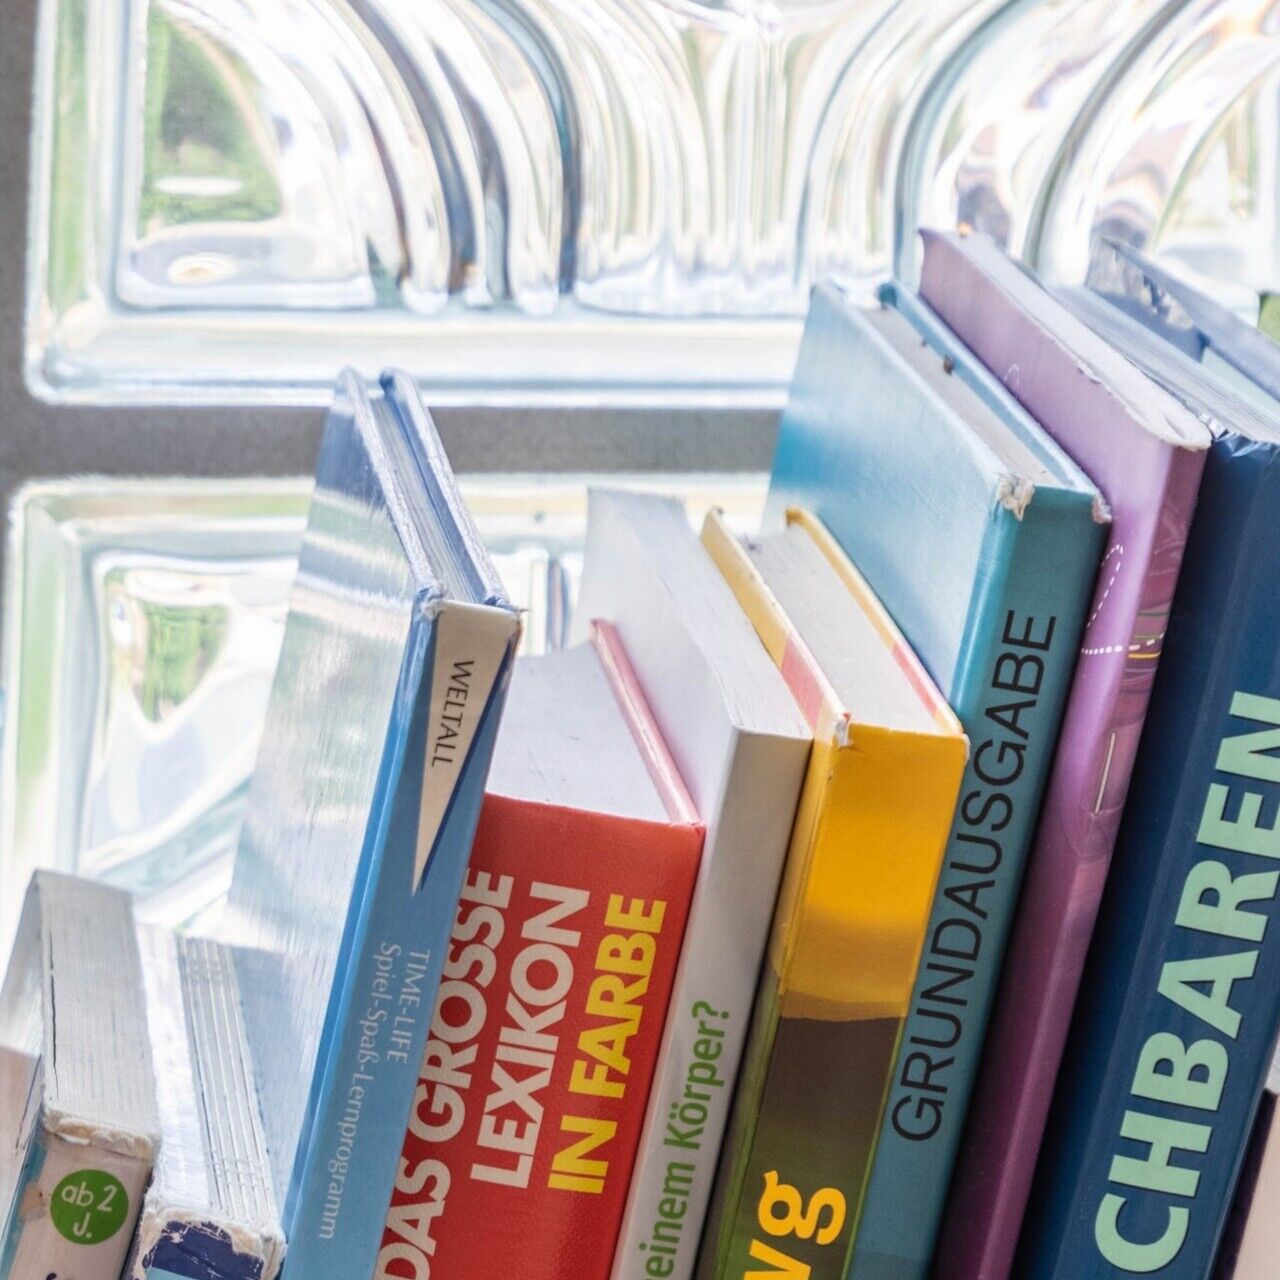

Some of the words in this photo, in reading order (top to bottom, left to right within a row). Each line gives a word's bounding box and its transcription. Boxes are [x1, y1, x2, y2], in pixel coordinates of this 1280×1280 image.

[431, 659, 474, 767] WELTALL
[891, 609, 1057, 1142] GRUNDAUSGABE
[408, 867, 515, 1143] GROSSE
[470, 882, 591, 1189] LEXIKON
[568, 894, 668, 1100] FARBE
[664, 1000, 730, 1151] Körper?
[547, 1115, 617, 1193] IN
